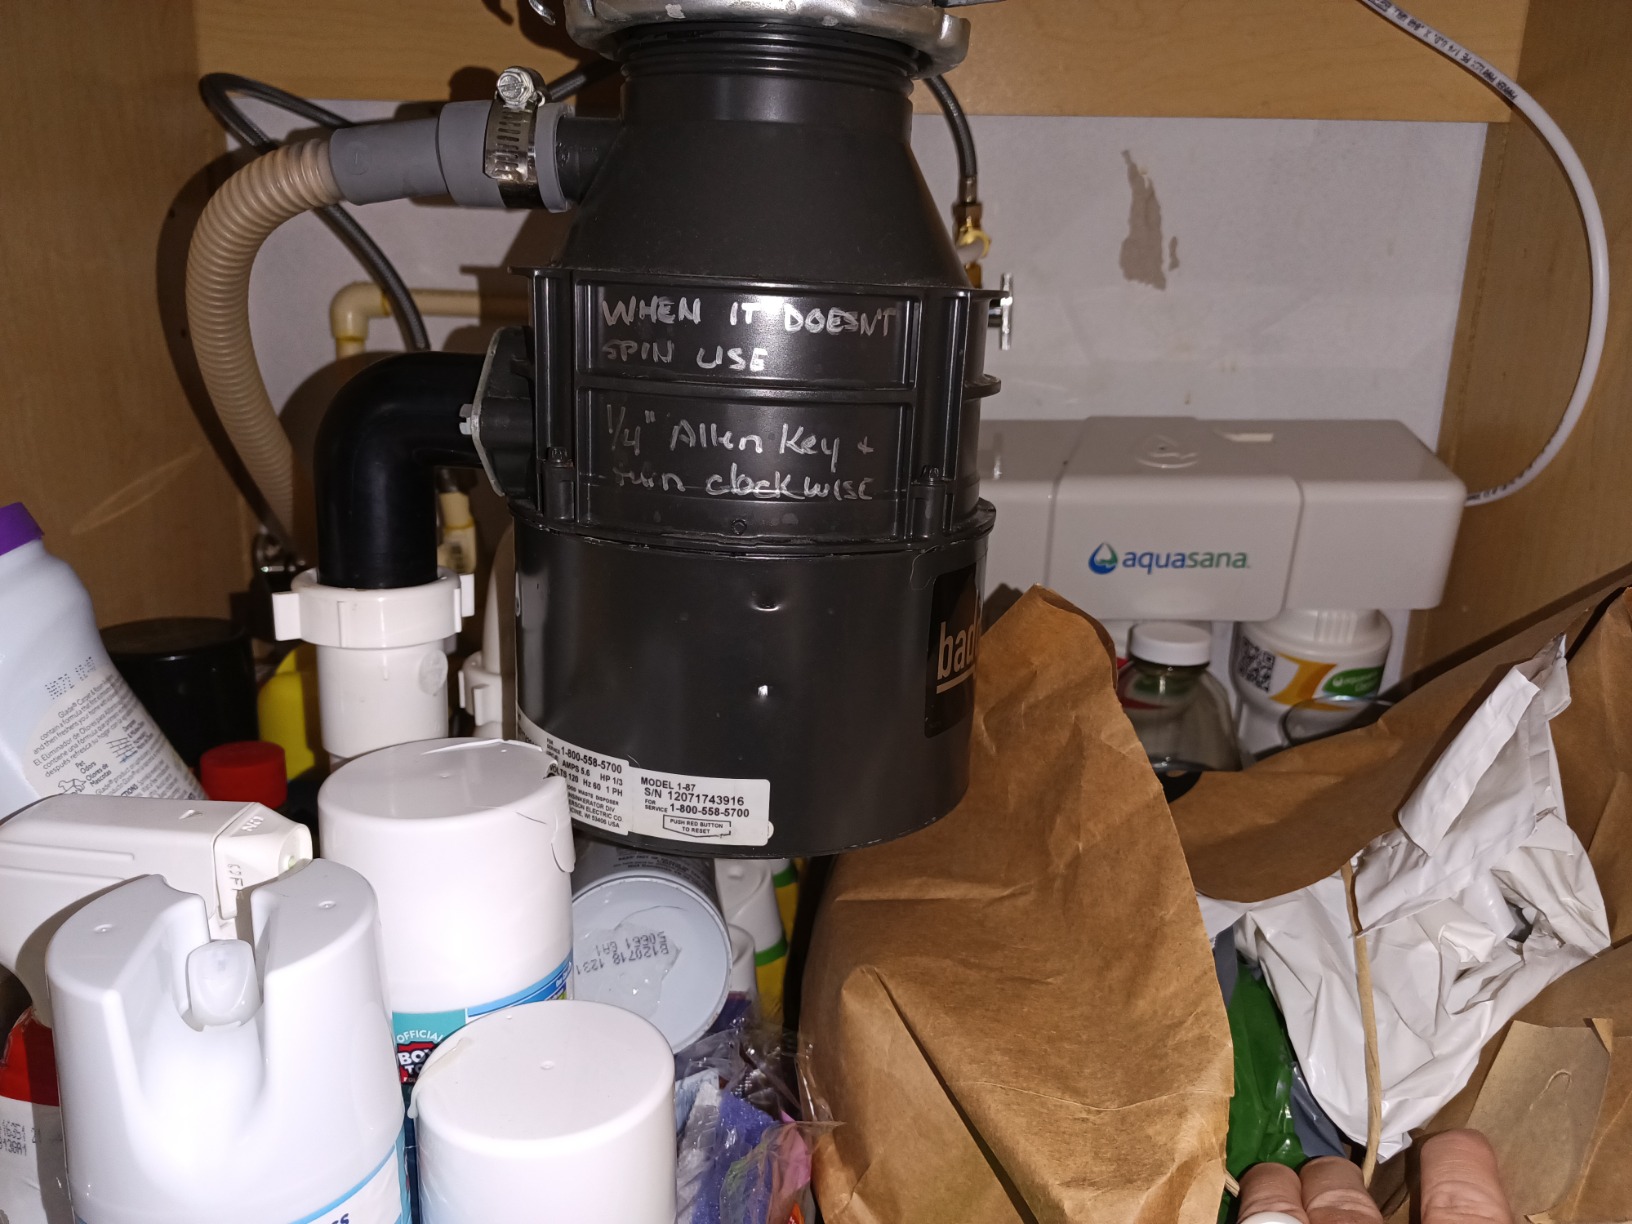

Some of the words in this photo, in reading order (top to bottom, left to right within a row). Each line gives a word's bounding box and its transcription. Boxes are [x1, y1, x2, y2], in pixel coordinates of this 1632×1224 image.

[601, 296, 701, 325] WHEN
[730, 301, 760, 325] IT
[602, 340, 675, 363] SPIN
[697, 345, 768, 372] USE
[670, 419, 763, 454] Allen
[779, 423, 840, 473] Key
[1122, 551, 1249, 575] aquasana
[62, 708, 82, 724] formula
[44, 735, 57, 746] then
[56, 720, 78, 738] freshens
[75, 759, 84, 768] Pet
[80, 760, 95, 773] Odors
[561, 746, 622, 774] 1-800-558-5700
[85, 766, 102, 780] Olores
[90, 768, 111, 786] Mascotas
[562, 760, 579, 773] AMPS
[581, 767, 591, 776] 5.6
[600, 773, 611, 782] HP
[613, 777, 623, 786] 1/3
[583, 778, 591, 787] Hz
[593, 782, 601, 790] 60
[612, 787, 623, 797] PH
[641, 777, 674, 790] MODEL
[677, 783, 696, 792] 1-87
[644, 787, 662, 798] S/N
[667, 791, 745, 806] 12071743916
[585, 806, 612, 819] ELECTRIC
[645, 805, 668, 813] SERVICE
[670, 803, 750, 818] 1-800-558-5700
[398, 1049, 432, 1065] BO
